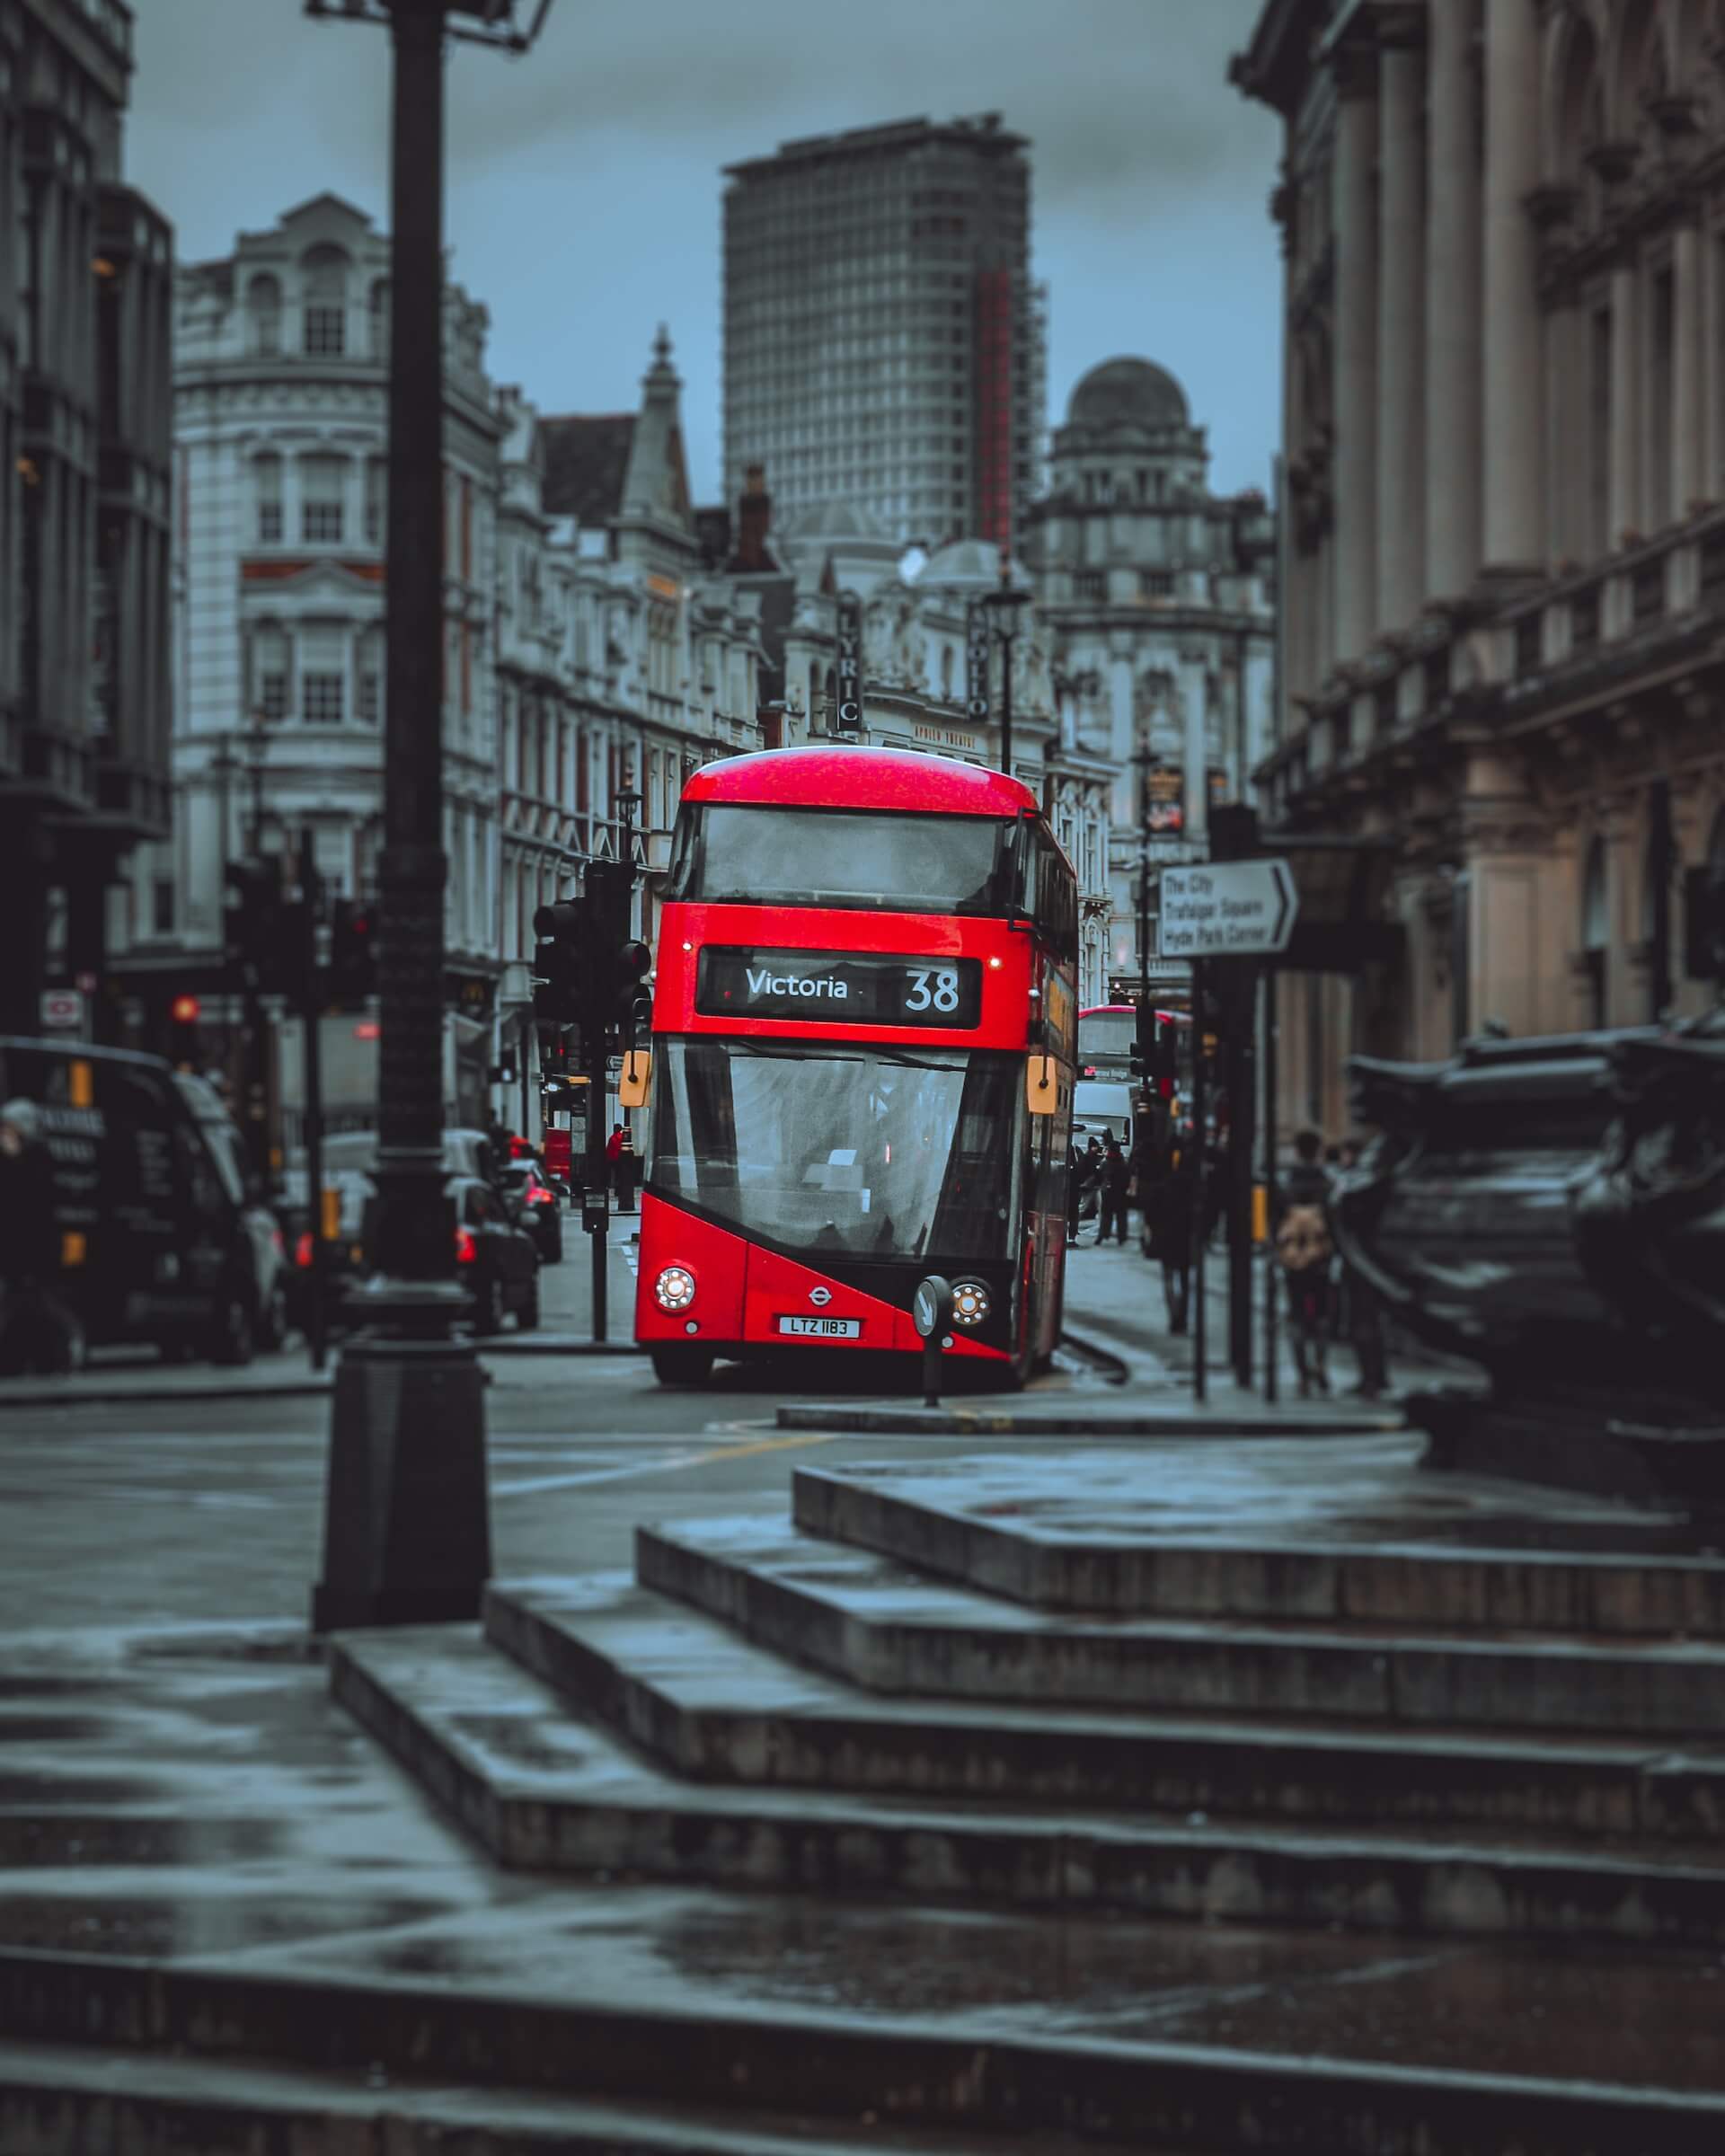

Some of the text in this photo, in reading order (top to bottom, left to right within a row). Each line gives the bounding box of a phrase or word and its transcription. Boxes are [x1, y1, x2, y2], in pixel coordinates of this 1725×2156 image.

[839, 612, 858, 721] LYRIC
[1165, 873, 1213, 895] The City
[1165, 897, 1263, 921] Trafalgar Square
[1165, 928, 1194, 950] Hyde
[1198, 925, 1223, 945] Park
[746, 968, 960, 1012] Victoria 38
[791, 1319, 847, 1334] LTZ 1183
